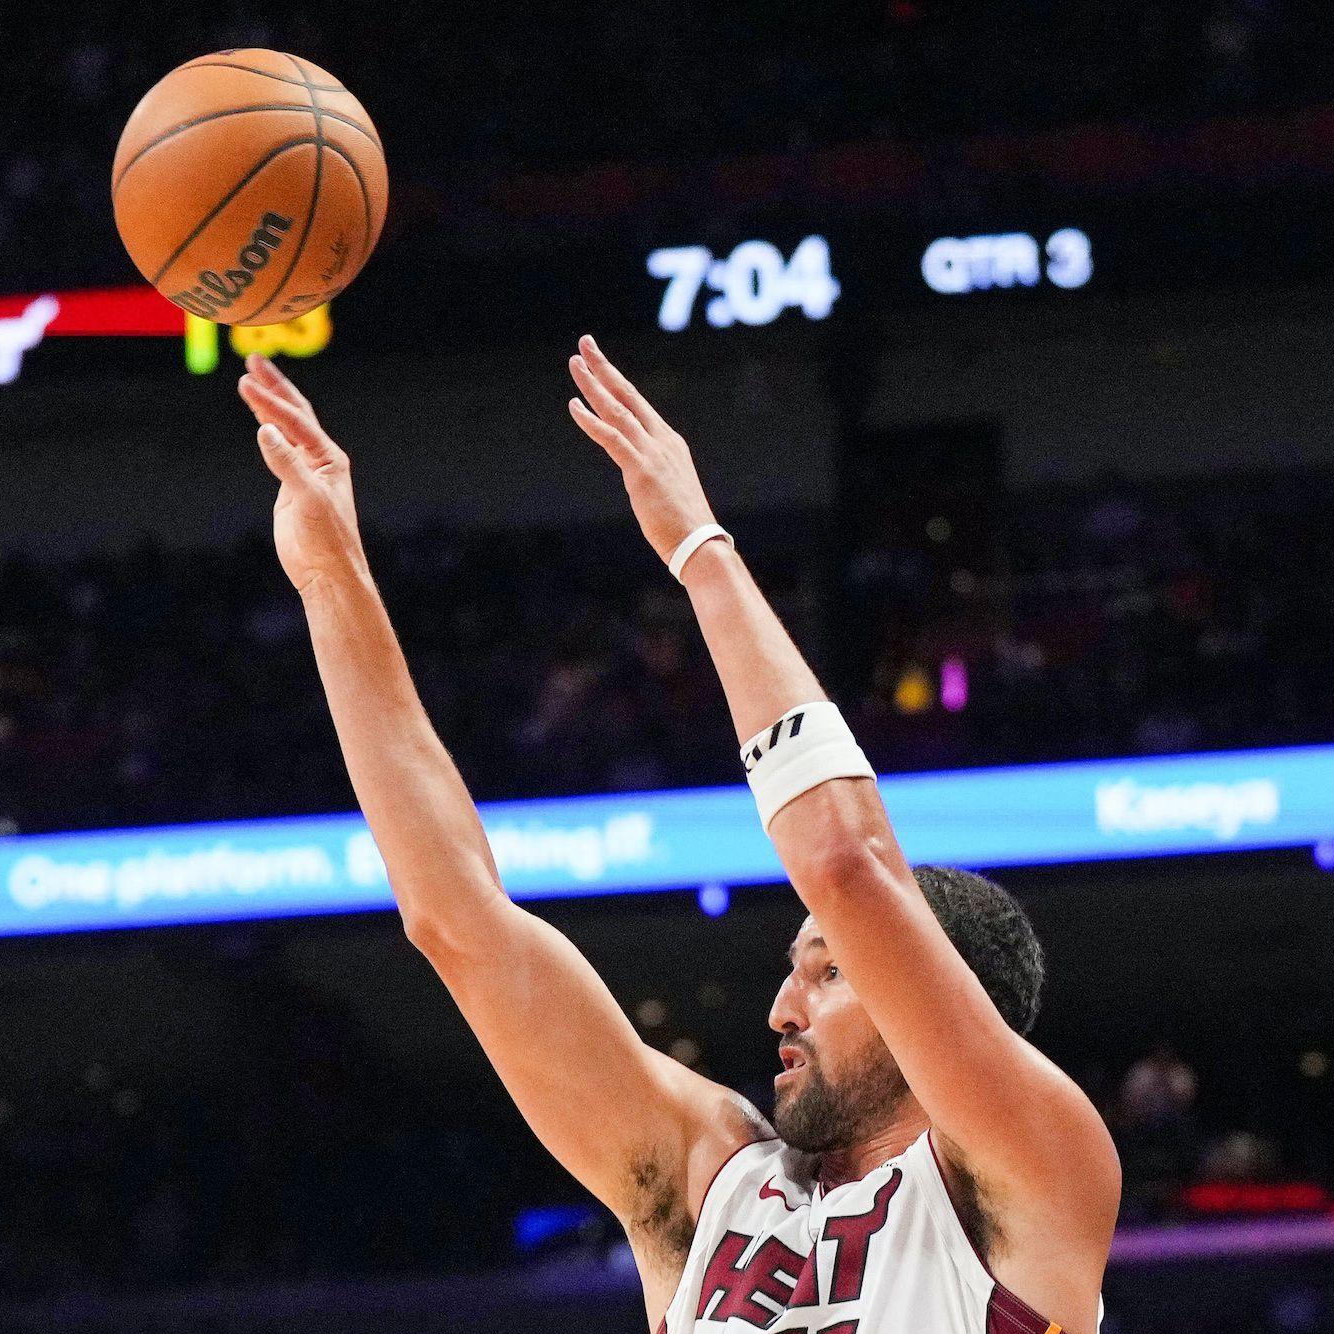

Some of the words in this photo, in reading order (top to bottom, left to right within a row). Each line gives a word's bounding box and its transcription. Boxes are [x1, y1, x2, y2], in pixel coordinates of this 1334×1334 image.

[646, 234, 840, 331] 7:04
[921, 231, 1040, 294] QTR
[696, 1167, 902, 1330] HEAT
